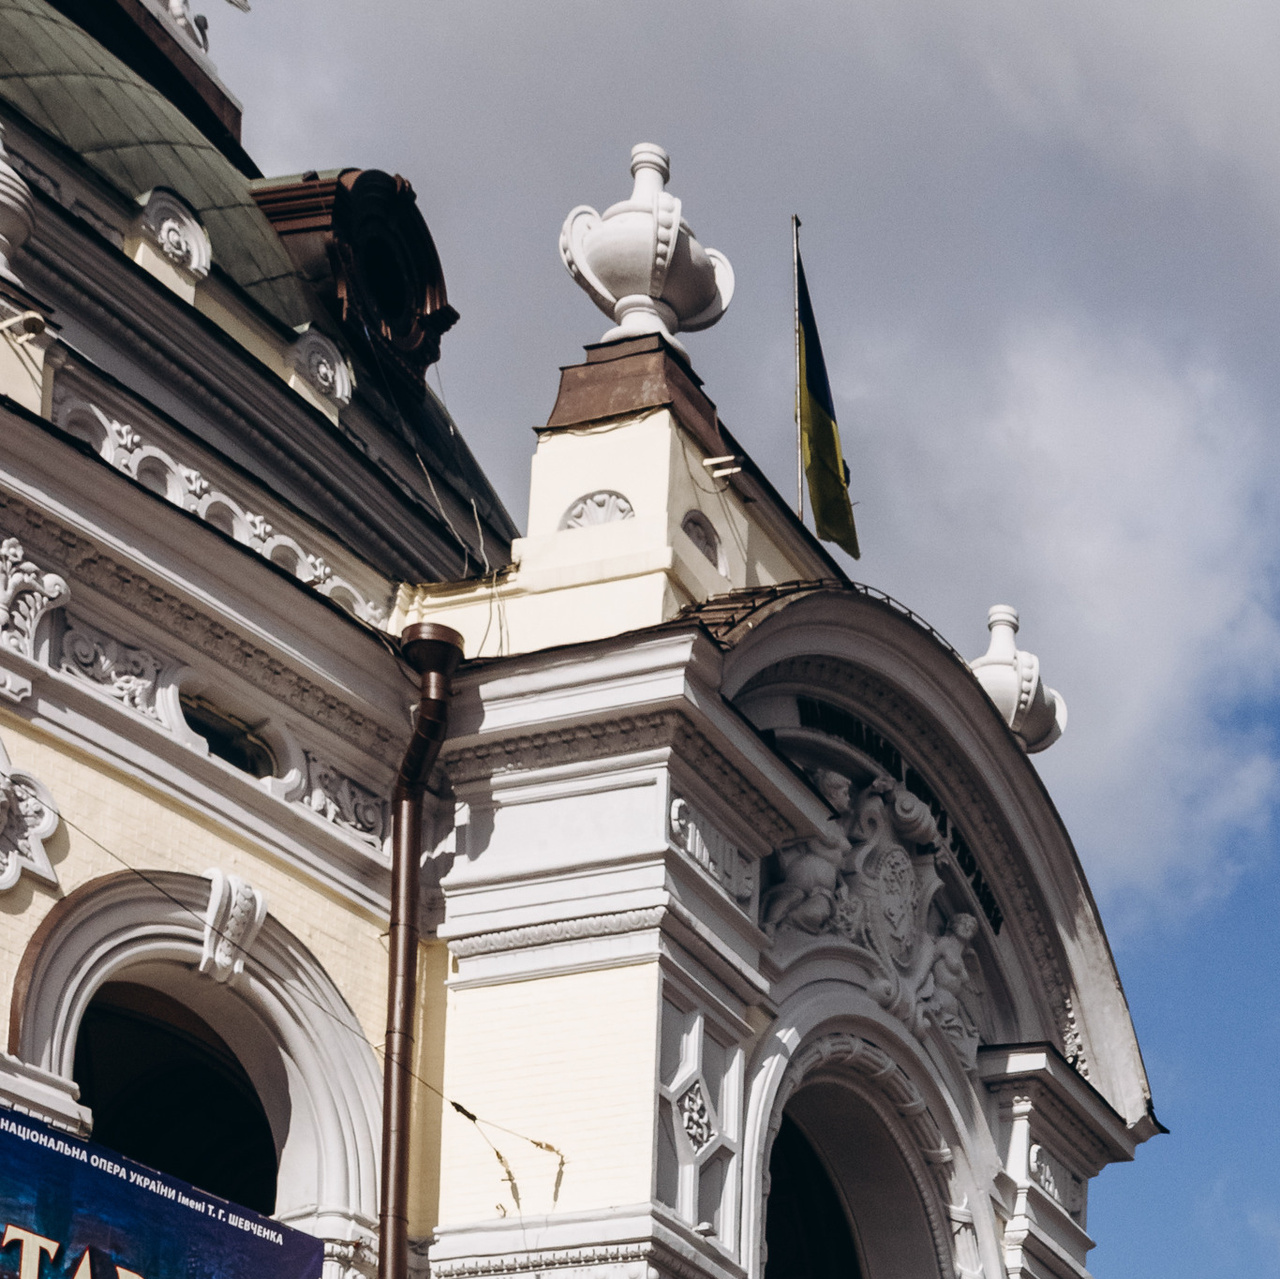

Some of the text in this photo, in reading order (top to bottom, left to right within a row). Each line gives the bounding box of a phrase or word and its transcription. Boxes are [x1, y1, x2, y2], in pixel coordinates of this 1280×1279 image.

[0, 1118, 284, 1246] НАЦІОНАЛЬНА ОПЕРА УКРАЇНИ імені Т. Г. ШЕВЧЕНКА
